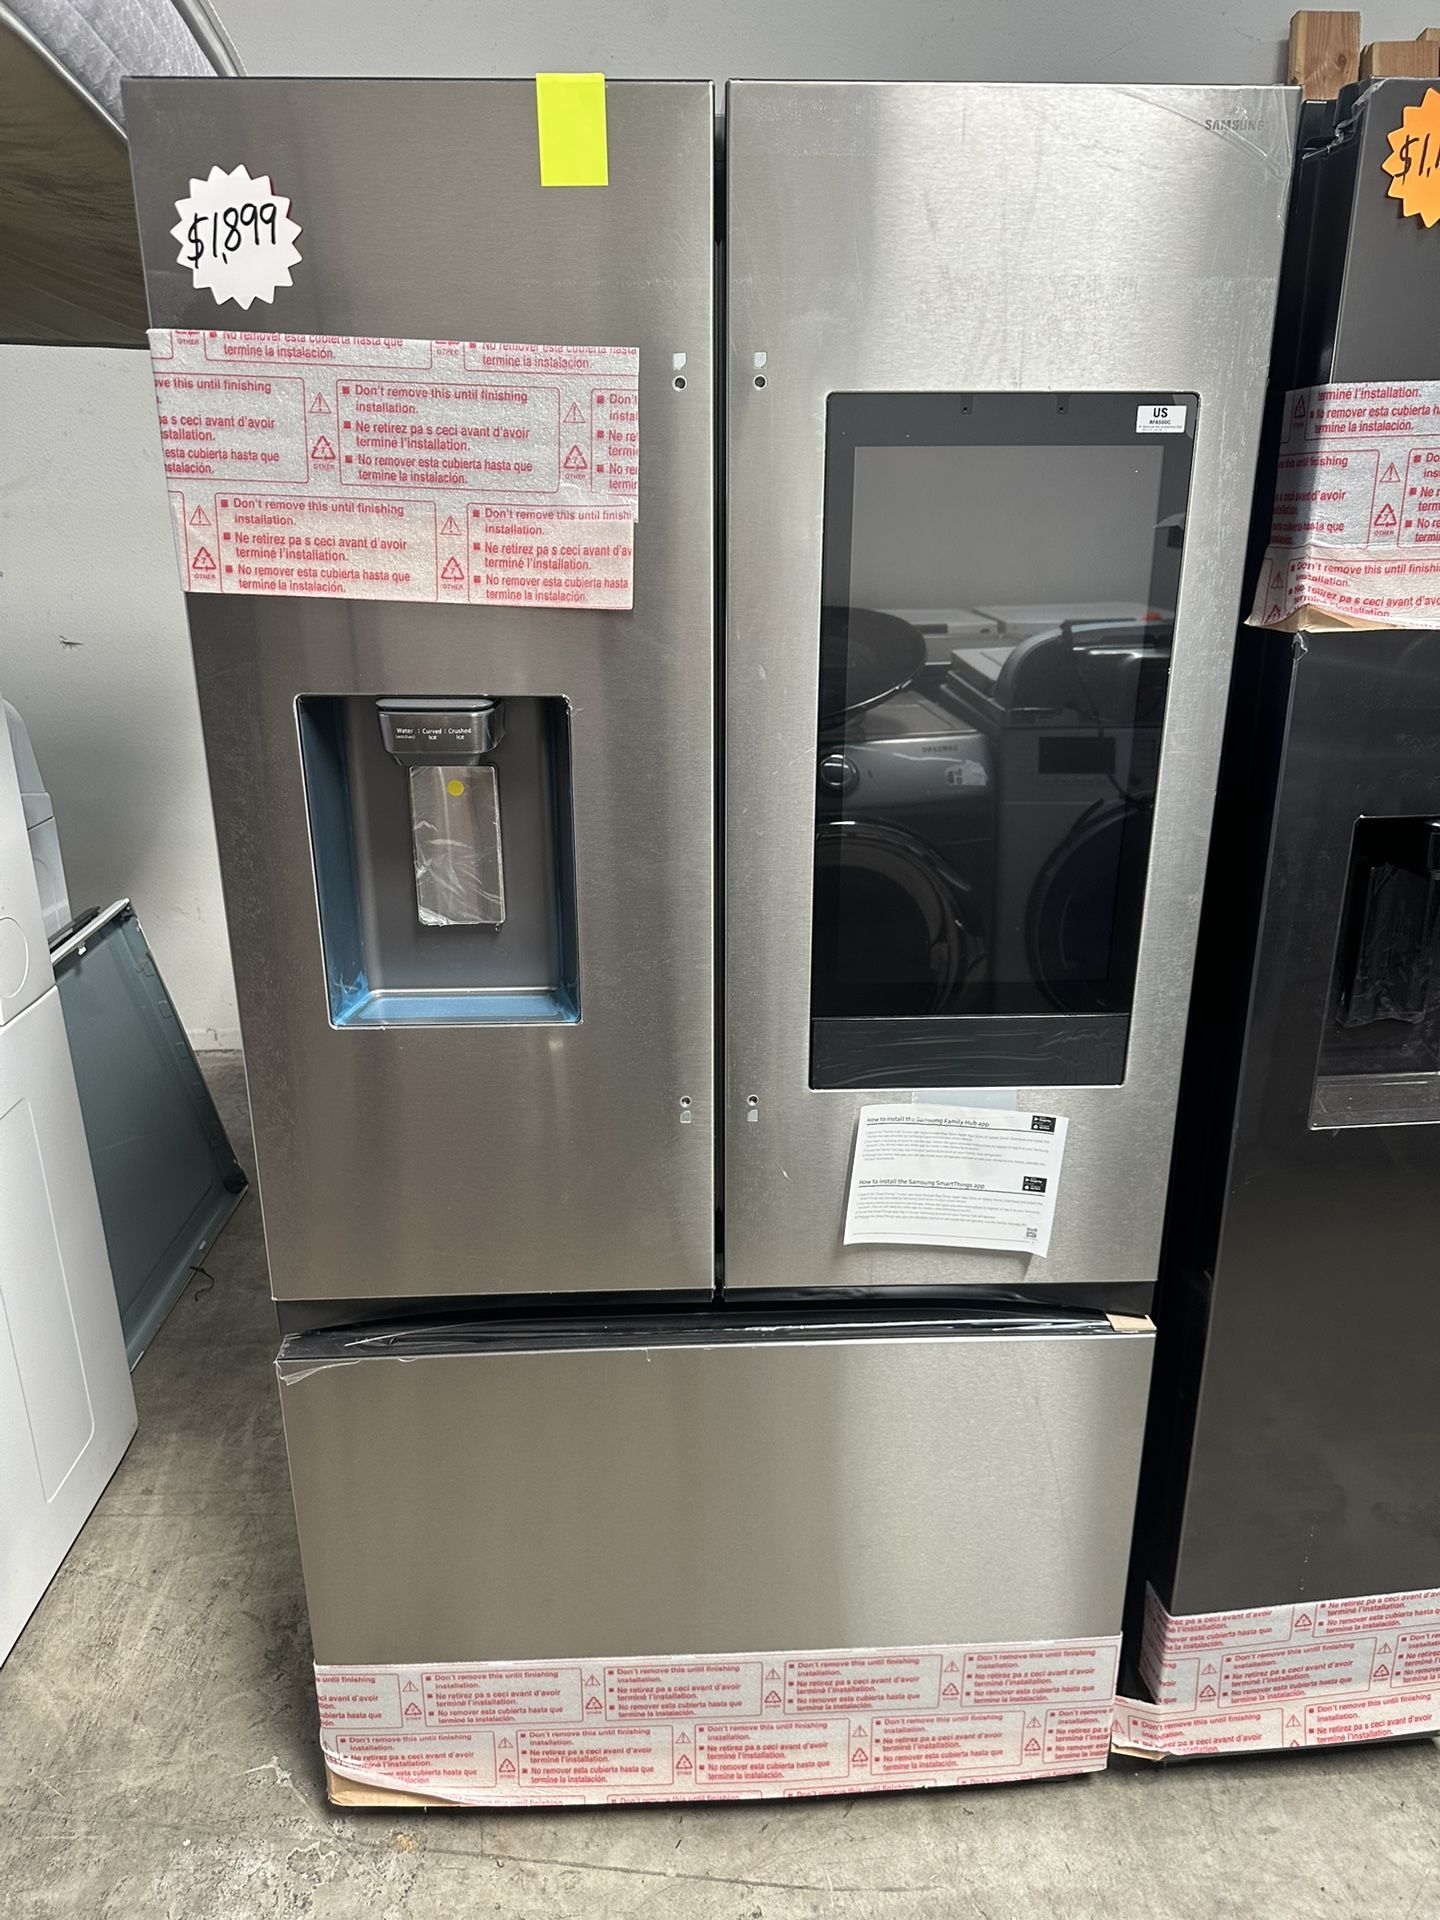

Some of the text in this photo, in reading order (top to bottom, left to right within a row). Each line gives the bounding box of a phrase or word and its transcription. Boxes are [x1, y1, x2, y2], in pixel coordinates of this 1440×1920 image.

[1205, 119, 1265, 131] SAMSUNG
[188, 203, 277, 269] $1,899
[224, 346, 336, 359] termine la instalación.
[483, 356, 520, 366] termine
[523, 357, 531, 367] la
[173, 379, 271, 394] this until finishing
[1355, 387, 1421, 399] l'installation.
[355, 385, 528, 404] Don't remove this until finishing
[356, 401, 419, 414] installation.
[1153, 408, 1168, 418] US
[1327, 405, 1430, 418] remover esta cubierta
[171, 415, 274, 428] s ceci avant d'avoir
[1348, 420, 1414, 432] la instalación.
[356, 421, 529, 438] Ne retirez pa s ceci avant d'avoir
[356, 436, 471, 450] terminé l'installation.
[165, 448, 279, 464] esta cubierta hasta que
[358, 454, 532, 474] No remover esta cubierta hasta que
[359, 469, 468, 483] termine la instalación.
[1420, 487, 1434, 498] Ne
[234, 498, 403, 516] Don't remove this until finishing
[235, 514, 296, 525] installation.
[485, 508, 512, 518] Don't
[516, 511, 554, 519] remove
[556, 509, 575, 519] this
[578, 509, 599, 520] until
[485, 524, 545, 535] installation.
[1327, 522, 1345, 533] que
[1417, 518, 1430, 529] No
[235, 533, 406, 549] Ne retirez pa s ceci avant d'avoir
[236, 548, 348, 560] terminé l'installation.
[485, 543, 498, 553] Ne
[502, 543, 532, 554] retirez
[536, 546, 548, 557] pa
[552, 546, 557, 554] s
[560, 544, 580, 555] ceci
[583, 544, 610, 555] avant
[485, 558, 592, 570] terminé l'installation.
[1324, 564, 1406, 574] remove this until
[238, 564, 410, 584] No remover esta cubierta hasta que
[239, 579, 346, 592] termine la instalación.
[486, 575, 628, 588] No remover esta cubierta hasta
[486, 589, 521, 600] termine
[524, 590, 532, 600] la
[1383, 1697, 1398, 1705] until
[1400, 1694, 1431, 1704] finishing
[1317, 1713, 1360, 1722] installation.
[1329, 1724, 1351, 1733] retirez
[1370, 1720, 1385, 1728] ceci
[1386, 1718, 1406, 1726] avant
[1408, 1714, 1432, 1723] d'avoir
